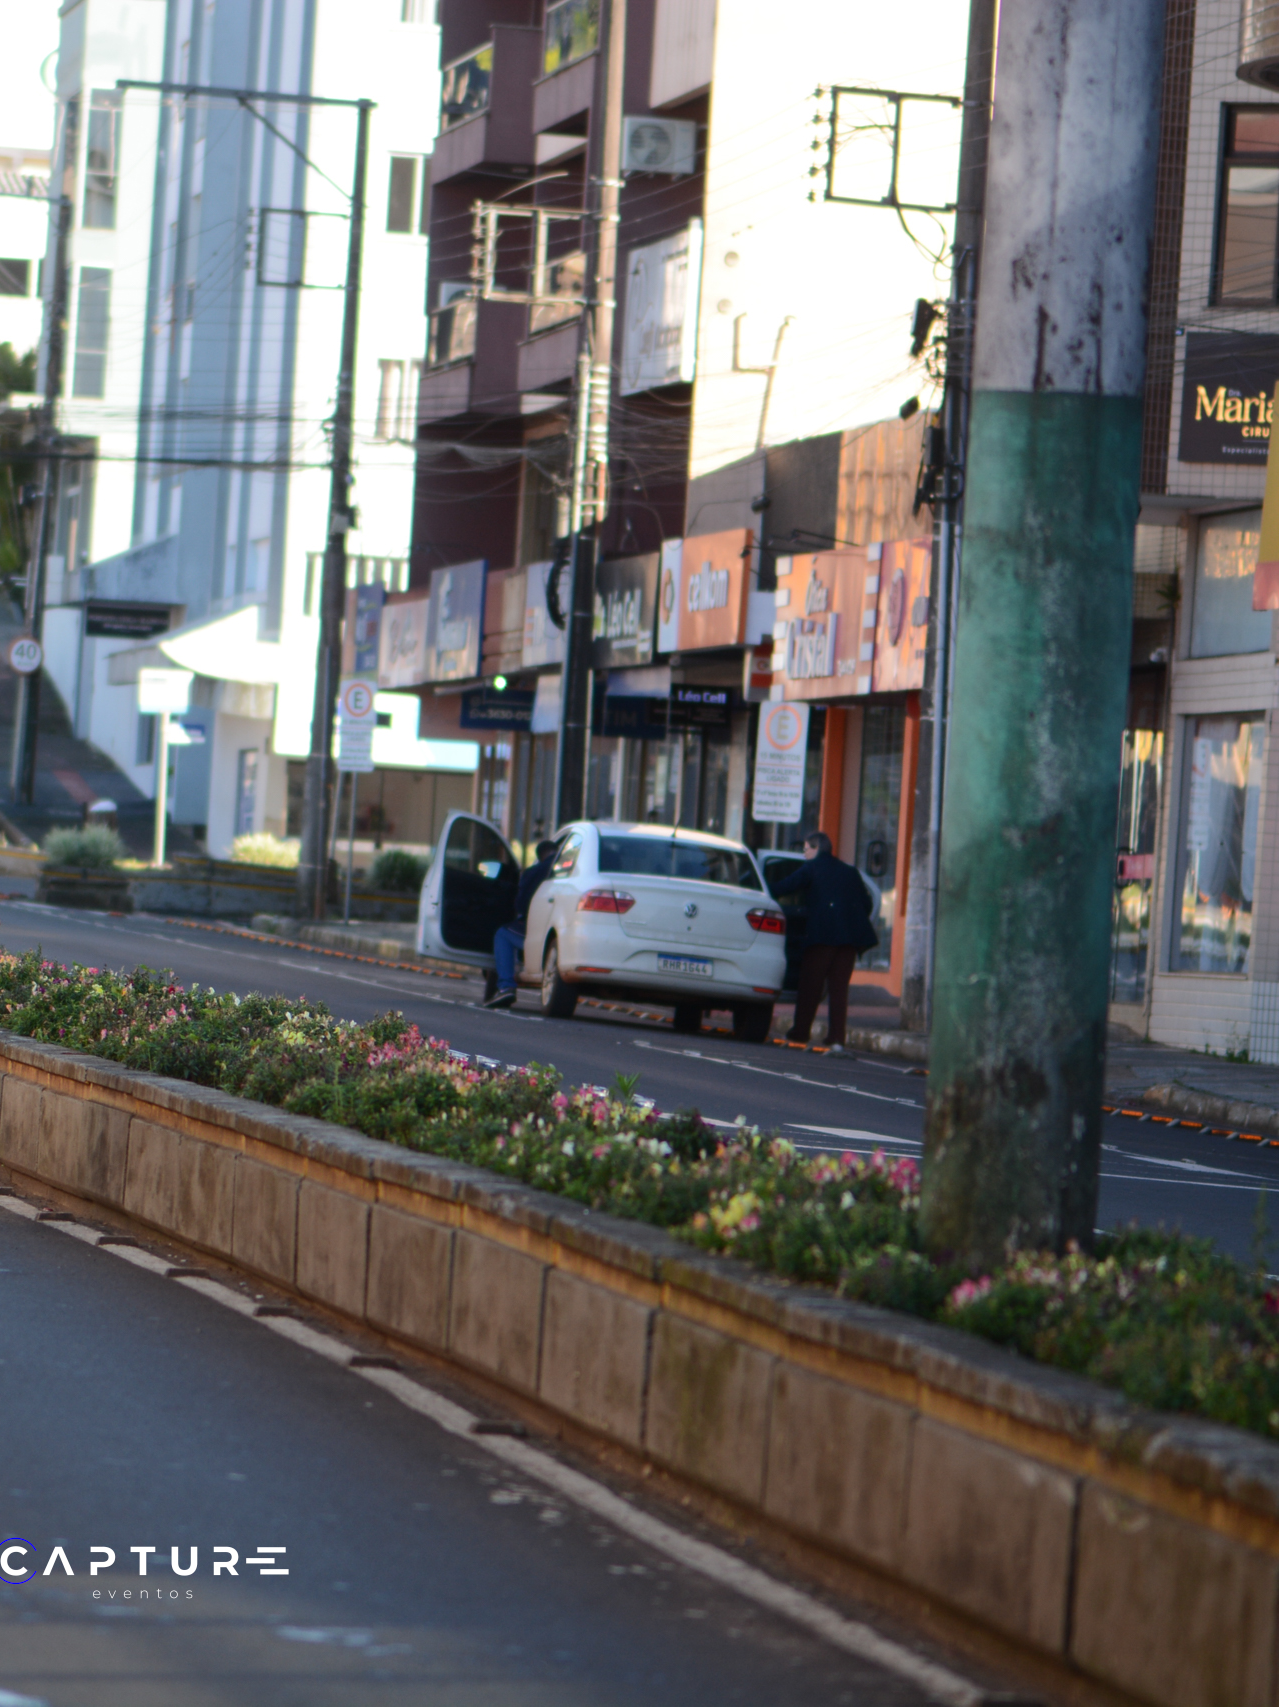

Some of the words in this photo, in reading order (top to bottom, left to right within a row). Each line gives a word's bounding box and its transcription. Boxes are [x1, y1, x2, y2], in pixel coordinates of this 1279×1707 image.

[15, 644, 37, 660] 40
[786, 612, 838, 680] Cristal
[354, 690, 364, 709] E
[678, 690, 701, 703] Léo
[702, 691, 727, 704] Cell
[776, 715, 790, 740] E
